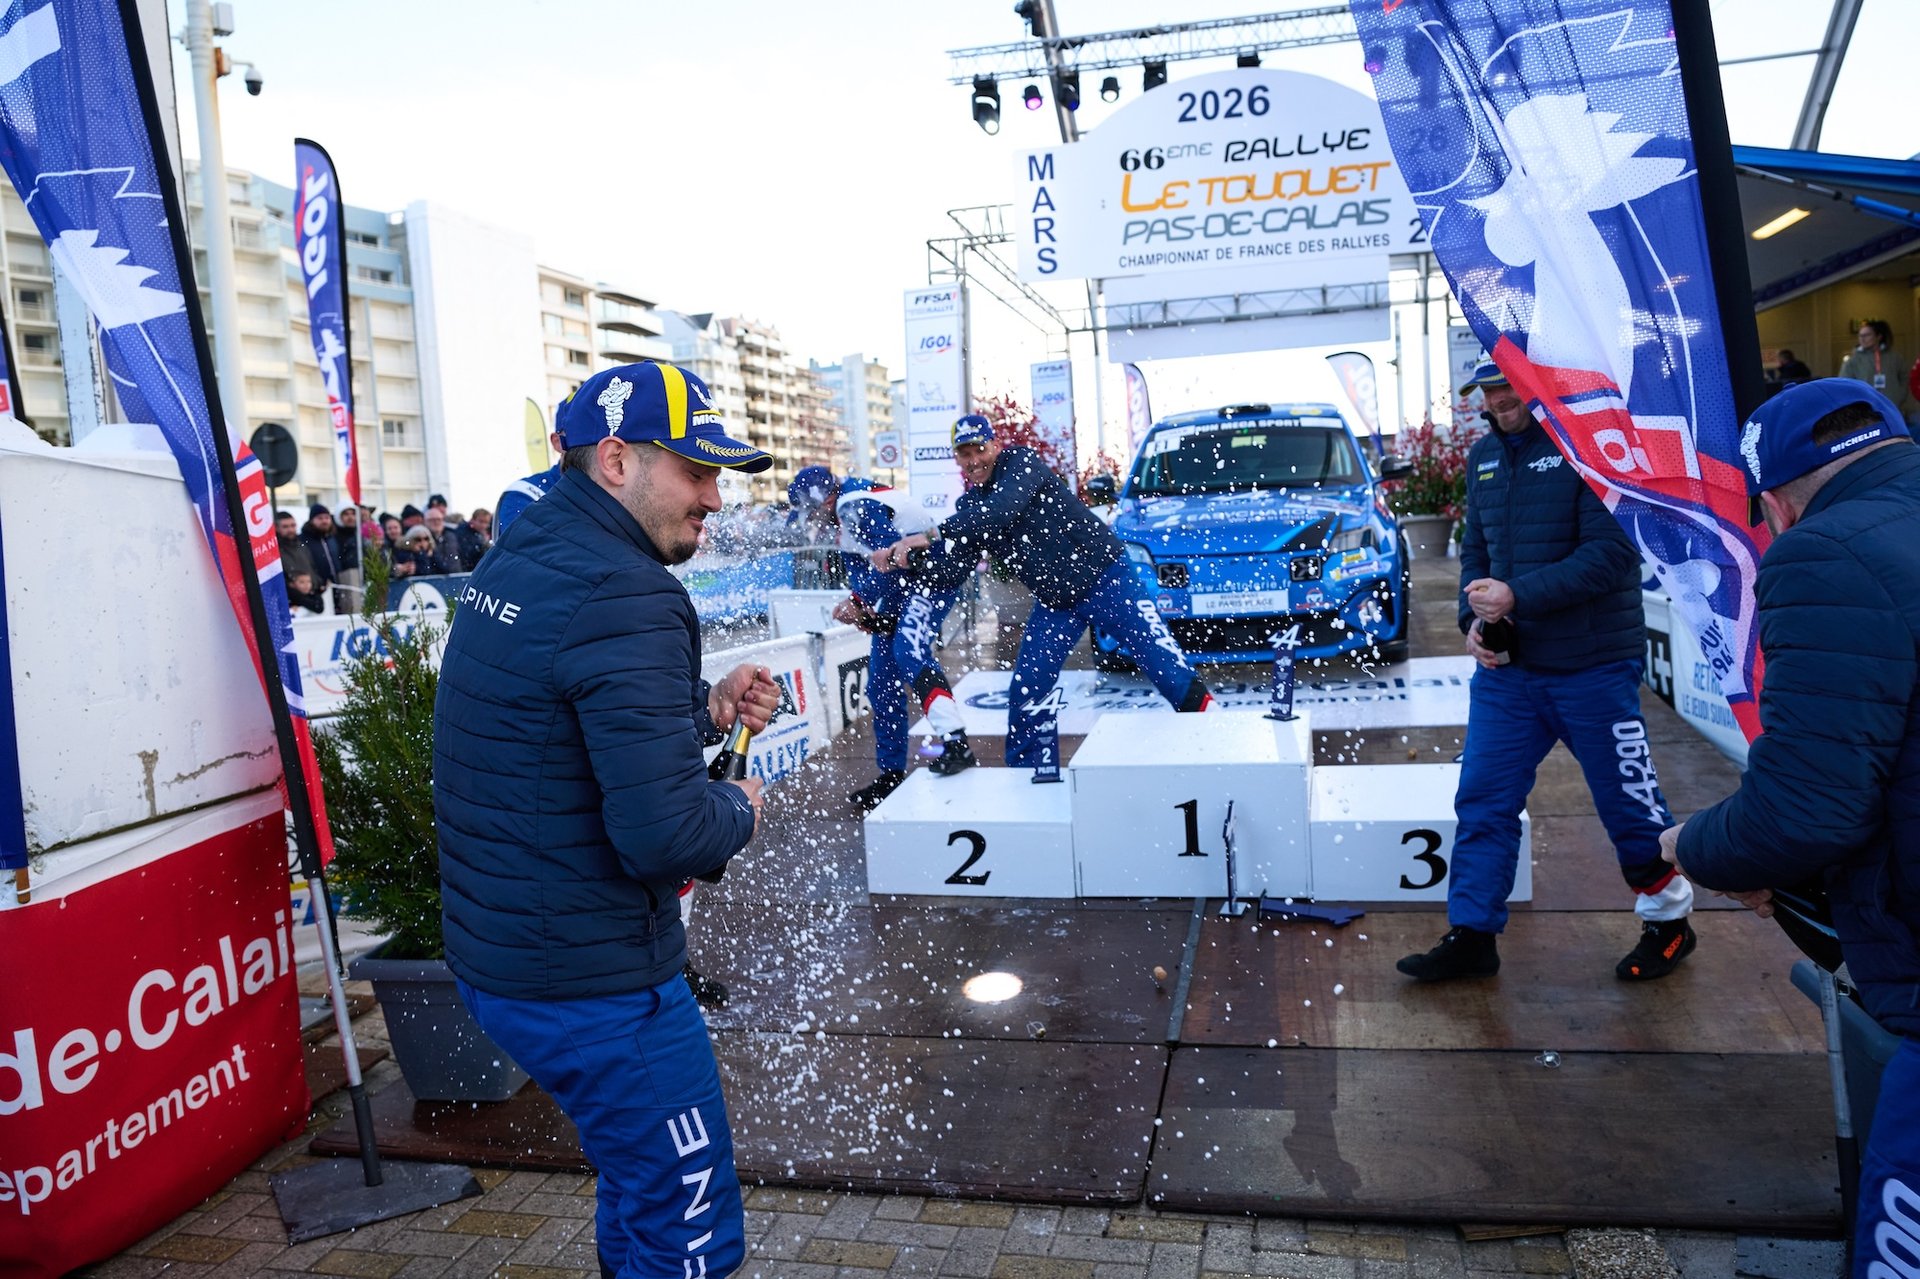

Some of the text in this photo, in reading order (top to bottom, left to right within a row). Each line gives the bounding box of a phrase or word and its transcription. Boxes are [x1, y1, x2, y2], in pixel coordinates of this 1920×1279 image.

[1178, 85, 1271, 122] 2026
[1224, 128, 1371, 163] RALLYE
[1198, 161, 1392, 206] TOUQUET
[1027, 153, 1058, 275] MARS
[1122, 199, 1392, 246] PAS-DE-CALAIS
[1408, 217, 1427, 244] 2
[302, 171, 329, 300] IGOL
[1118, 233, 1391, 268] CHAMPIONNAT DE FRANCE DES RALLYES
[914, 292, 952, 305] FFSA
[920, 334, 952, 349] IGOL
[1258, 418, 1301, 428] SPORT
[1830, 428, 1881, 454] MICHELIN
[460, 583, 521, 625] LPINE
[1276, 683, 1284, 700] 3
[751, 736, 809, 786] ALLYE
[1041, 747, 1052, 763] 2
[1612, 720, 1665, 826] A290
[1173, 799, 1209, 858] 1
[944, 830, 991, 886] 2
[1400, 829, 1448, 889] 3
